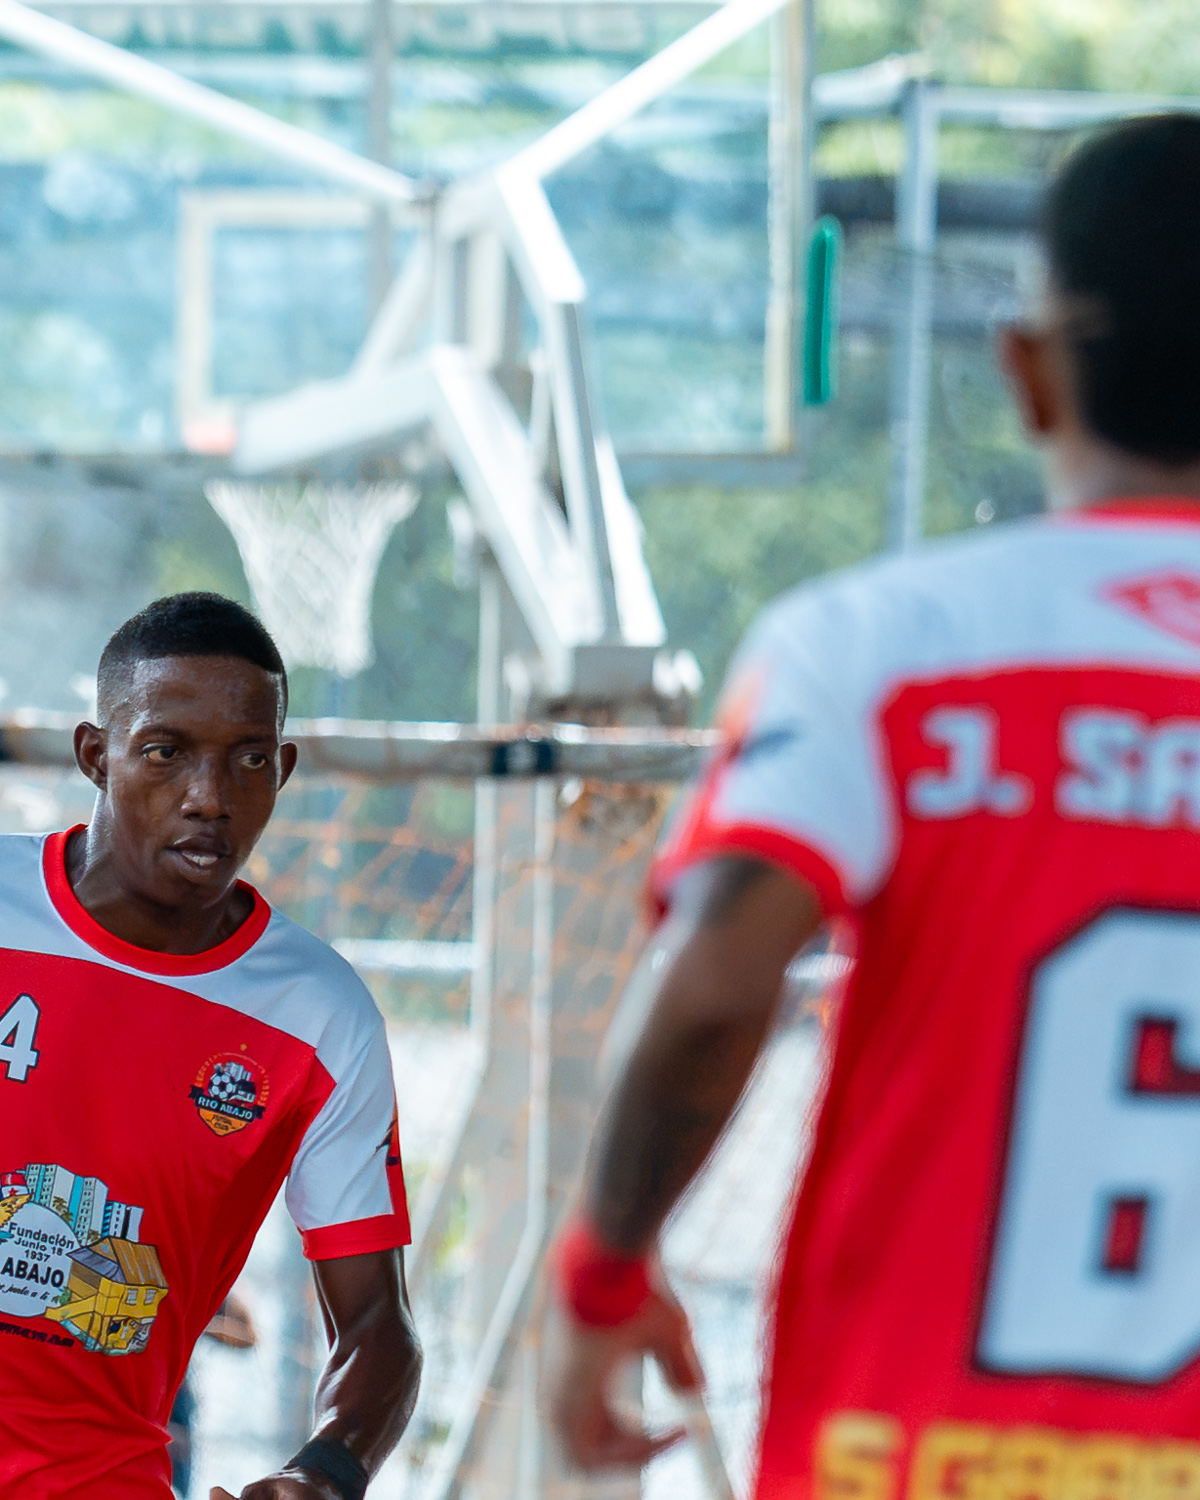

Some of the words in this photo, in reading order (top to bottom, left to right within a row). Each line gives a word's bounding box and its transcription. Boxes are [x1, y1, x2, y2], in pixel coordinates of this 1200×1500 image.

[910, 706, 1031, 817] J.
[197, 1096, 218, 1110] RIO
[219, 1103, 253, 1120] ABAJO
[8, 1221, 74, 1249] Fundación
[14, 1238, 47, 1251] Junio
[24, 1248, 51, 1262] 1937
[0, 1256, 65, 1287] ABAJO
